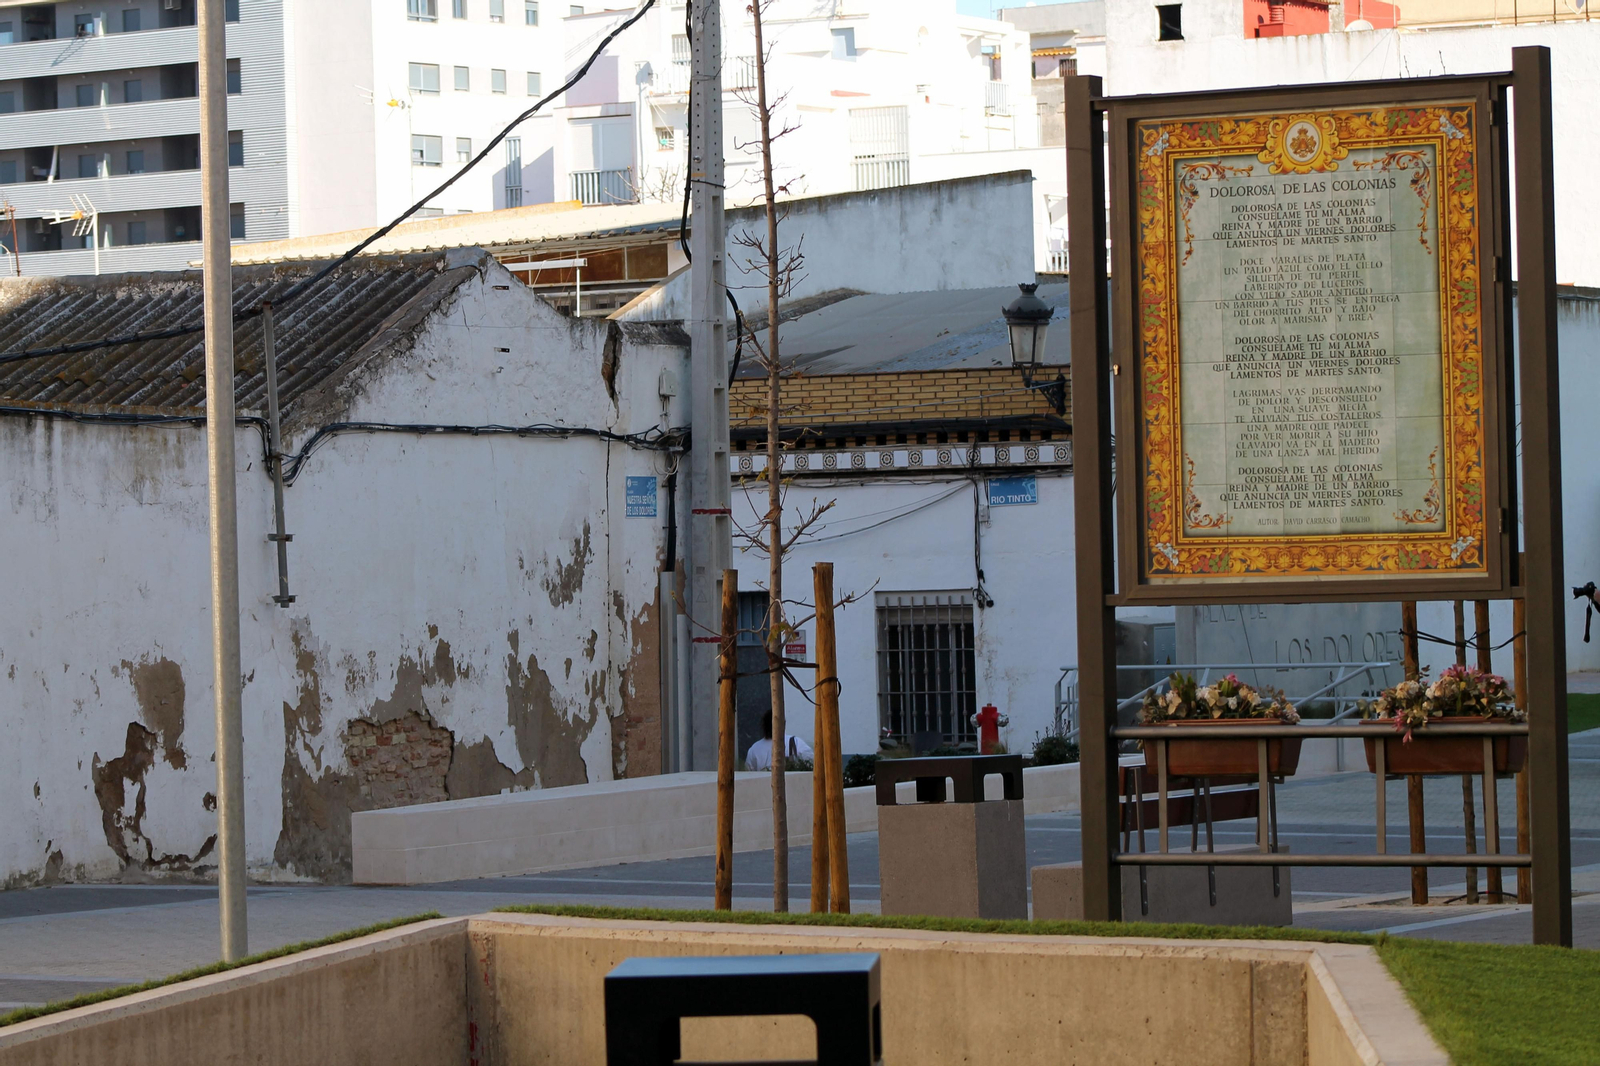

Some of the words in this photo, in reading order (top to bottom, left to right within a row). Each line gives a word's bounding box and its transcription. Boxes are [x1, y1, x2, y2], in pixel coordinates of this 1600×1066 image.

[1210, 185, 1275, 198] DOLOROSA
[1283, 183, 1300, 194] DE
[1303, 182, 1326, 193] LAS
[1332, 178, 1396, 192] COLONIAS
[1231, 203, 1283, 213] DOLOROSA
[1304, 201, 1321, 210] LAS
[1328, 198, 1376, 208] COLONIAS
[1221, 222, 1250, 231] REINA
[1268, 220, 1302, 229] MADRE
[1308, 219, 1320, 227] DE
[1326, 218, 1340, 226] UN
[1346, 216, 1383, 224] BARRIO
[1212, 232, 1233, 240] QUE
[1237, 229, 1283, 239] ANUNCIA
[1286, 228, 1301, 237] UN
[1305, 226, 1344, 235] VIERNES
[1350, 224, 1396, 233] DOLORES
[1227, 238, 1277, 248] LAMENTOS
[1283, 237, 1296, 246] DE
[1301, 236, 1340, 245] MARTES
[1240, 258, 1264, 266] DOCE
[1271, 255, 1314, 264] VARALES
[1318, 254, 1330, 263] DE
[1336, 253, 1366, 262] PLATA
[1224, 267, 1238, 275] UN
[1244, 266, 1271, 275] PALIO
[1278, 264, 1302, 273] AZUL
[1306, 263, 1334, 272] COMO
[1356, 261, 1383, 269] CIELO
[1247, 274, 1284, 283] SILUETA
[1329, 270, 1360, 279] PERFIL
[1244, 282, 1297, 292] LABERINTO
[1321, 280, 1364, 289] LUCEROS
[1235, 292, 1256, 300] CON
[1260, 290, 1285, 299] VIEJO
[1291, 289, 1323, 298] SABOR
[1328, 287, 1373, 296] ANTIGUO
[1233, 300, 1269, 309] BARRIO
[1286, 298, 1304, 307] TUS
[1310, 297, 1330, 306] PIES
[1336, 296, 1347, 305] SE
[1355, 295, 1400, 304] ENTREGA
[1233, 308, 1252, 318] DEL
[1254, 307, 1301, 317] CHORRITO
[1308, 306, 1332, 314] ALTO
[1352, 304, 1376, 313] BAJO
[1239, 317, 1265, 326] OLOR
[1284, 314, 1328, 324] MARISMA
[1349, 313, 1373, 322] BREA
[1235, 335, 1286, 345] DOLOROSA
[1290, 334, 1301, 343] DE
[1307, 333, 1324, 342] LAS
[1330, 332, 1380, 341] COLONIAS
[1345, 340, 1371, 349] ALMA
[1226, 353, 1255, 362] REINA
[1272, 351, 1306, 360] MADRE
[1311, 350, 1323, 358] DE
[1350, 348, 1386, 357] BARRIO
[1213, 363, 1231, 372] QUE
[1237, 361, 1281, 371] ANUNCIA
[1288, 360, 1303, 369] UN
[1309, 358, 1349, 367] VIERNES
[1356, 356, 1401, 366] DOLORES
[1231, 369, 1281, 380] LAMENTOS
[1287, 369, 1299, 378] DE
[1305, 367, 1344, 377] MARTES
[1288, 387, 1306, 396] VAS
[1312, 384, 1382, 395] DERRAMANDO
[1238, 397, 1251, 406] DE
[1256, 396, 1290, 406] DOLOR
[1308, 394, 1377, 404] DESCONSUELO
[1252, 405, 1264, 414] EN
[1274, 404, 1295, 413] UNA
[1299, 404, 1331, 412] SUAVE
[1235, 414, 1245, 423] TE
[1250, 412, 1290, 422] ALIVIAN
[1297, 412, 1314, 421] TUS
[1247, 423, 1269, 432] UNA
[1276, 422, 1307, 431] MADRE
[1310, 422, 1330, 430] QUE
[1333, 420, 1369, 430] PADECE
[1241, 432, 1259, 440] POR
[1264, 432, 1282, 440] VER
[1290, 430, 1320, 439] MORIR
[1338, 429, 1353, 438] SU
[1357, 429, 1378, 437] HIJO
[1236, 440, 1280, 450] CLAVADO
[1287, 440, 1299, 448] VA
[1304, 439, 1317, 448] EN
[1323, 439, 1333, 447] EL
[1339, 437, 1380, 447] MADERO
[1235, 449, 1248, 458] DE
[1253, 448, 1272, 457] UNA
[1278, 447, 1310, 457] LANZA
[1317, 447, 1337, 456] MAL
[1343, 446, 1380, 455] HERIDO
[1238, 466, 1289, 475] DOLOROSA
[1293, 465, 1305, 474] DE
[1311, 464, 1328, 473] LAS
[1334, 463, 1383, 472] COLONIAS
[1332, 473, 1343, 481] MI
[1347, 471, 1374, 480] ALMA
[1229, 484, 1258, 492] REINA
[1276, 482, 1309, 492] MADRE
[1314, 482, 1327, 490] DE
[1333, 481, 1347, 490] UN
[1353, 480, 1389, 489] BARRIO
[1007, 494, 1032, 502] TINTO
[1220, 492, 1239, 501] QUE
[1244, 490, 1290, 500] ANUNCIA
[1294, 490, 1308, 499] UN
[1312, 489, 1352, 498] VIERNES
[1358, 488, 1403, 496] DOLORES
[1233, 499, 1284, 509] LAMENTOS
[1289, 499, 1302, 508] DE
[1308, 497, 1347, 508] MARTES
